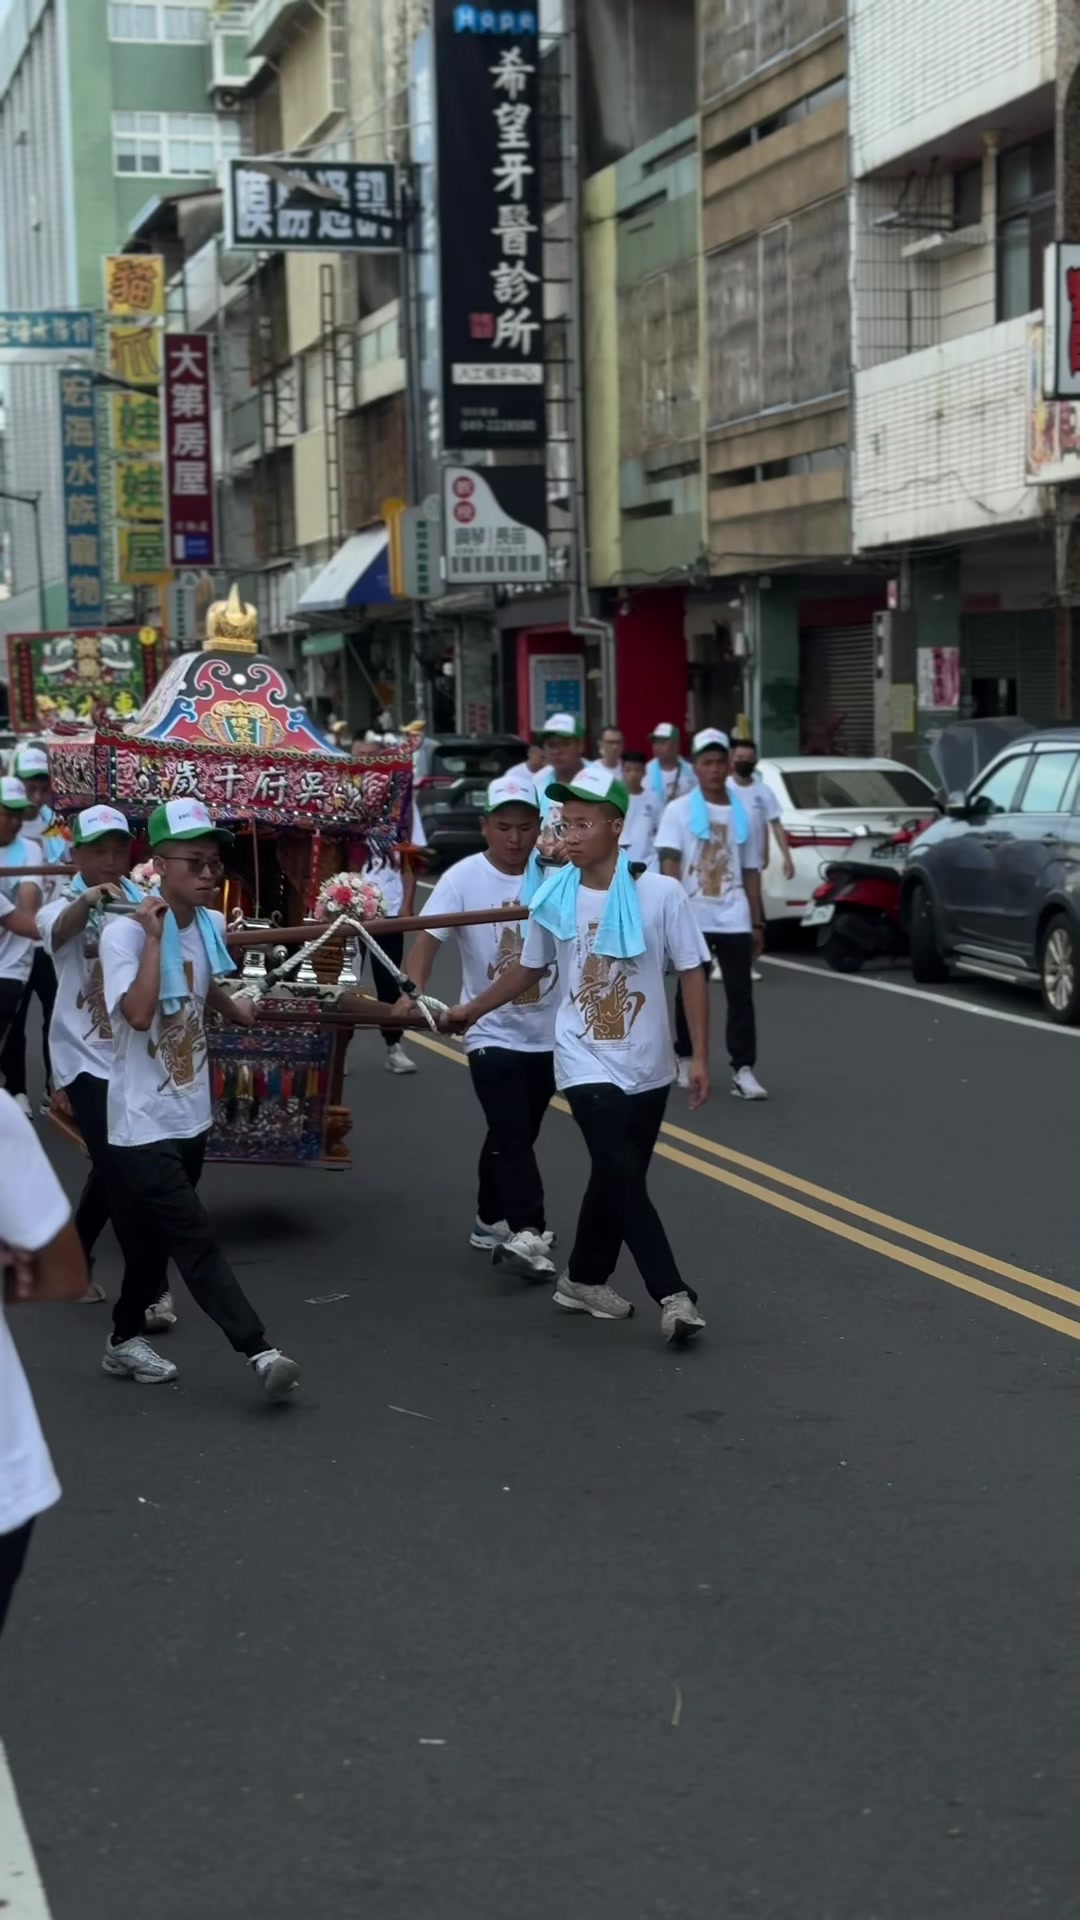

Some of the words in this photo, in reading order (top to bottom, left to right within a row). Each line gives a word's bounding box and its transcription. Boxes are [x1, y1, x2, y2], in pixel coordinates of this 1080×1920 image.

[455, 4, 536, 34] Hope
[489, 46, 540, 355] 希望牙醫診所
[63, 375, 99, 606] 宏海水族寵物
[170, 343, 208, 495] 大第房屋
[168, 759, 329, 806] 吳府千歲
